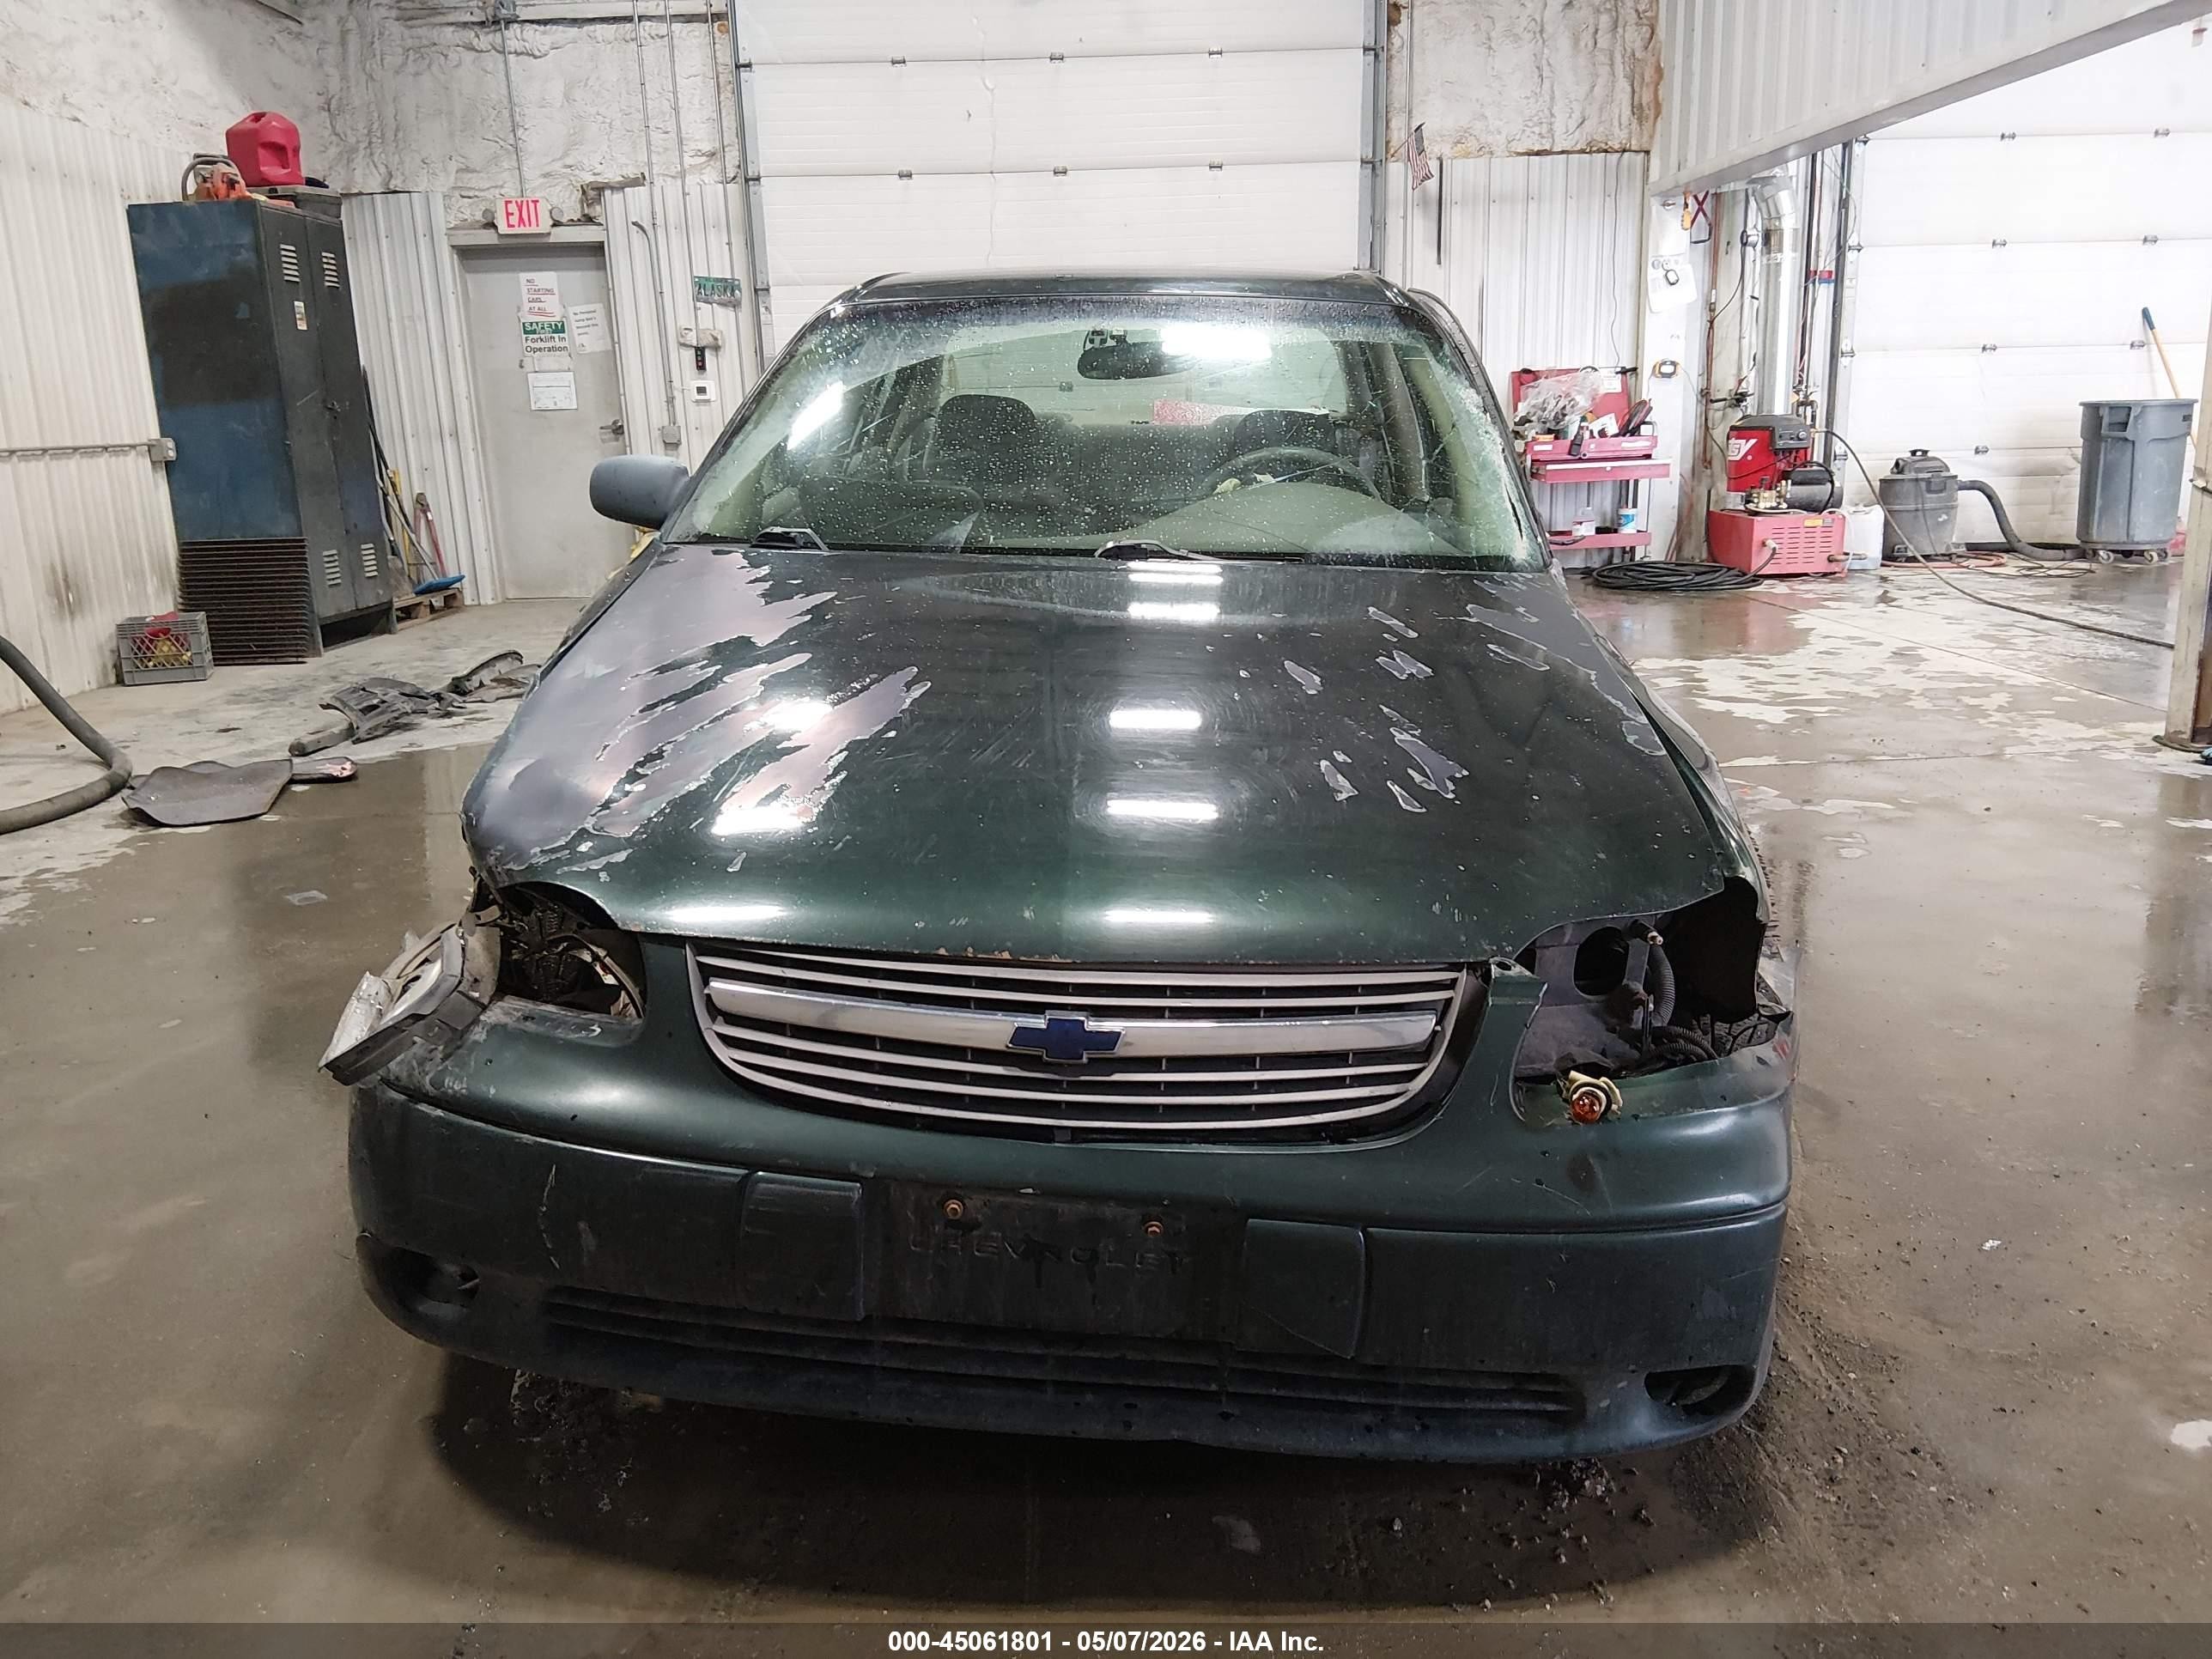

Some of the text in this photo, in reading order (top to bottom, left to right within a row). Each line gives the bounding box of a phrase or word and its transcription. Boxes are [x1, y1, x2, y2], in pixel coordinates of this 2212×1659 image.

[504, 198, 540, 228] EXIT
[696, 283, 736, 299] ALASKA
[525, 321, 563, 331] SAFETY
[525, 335, 556, 344] Forklift
[557, 334, 567, 343] In
[525, 345, 568, 354] Operation
[908, 1226, 1190, 1272] CHEVROLET
